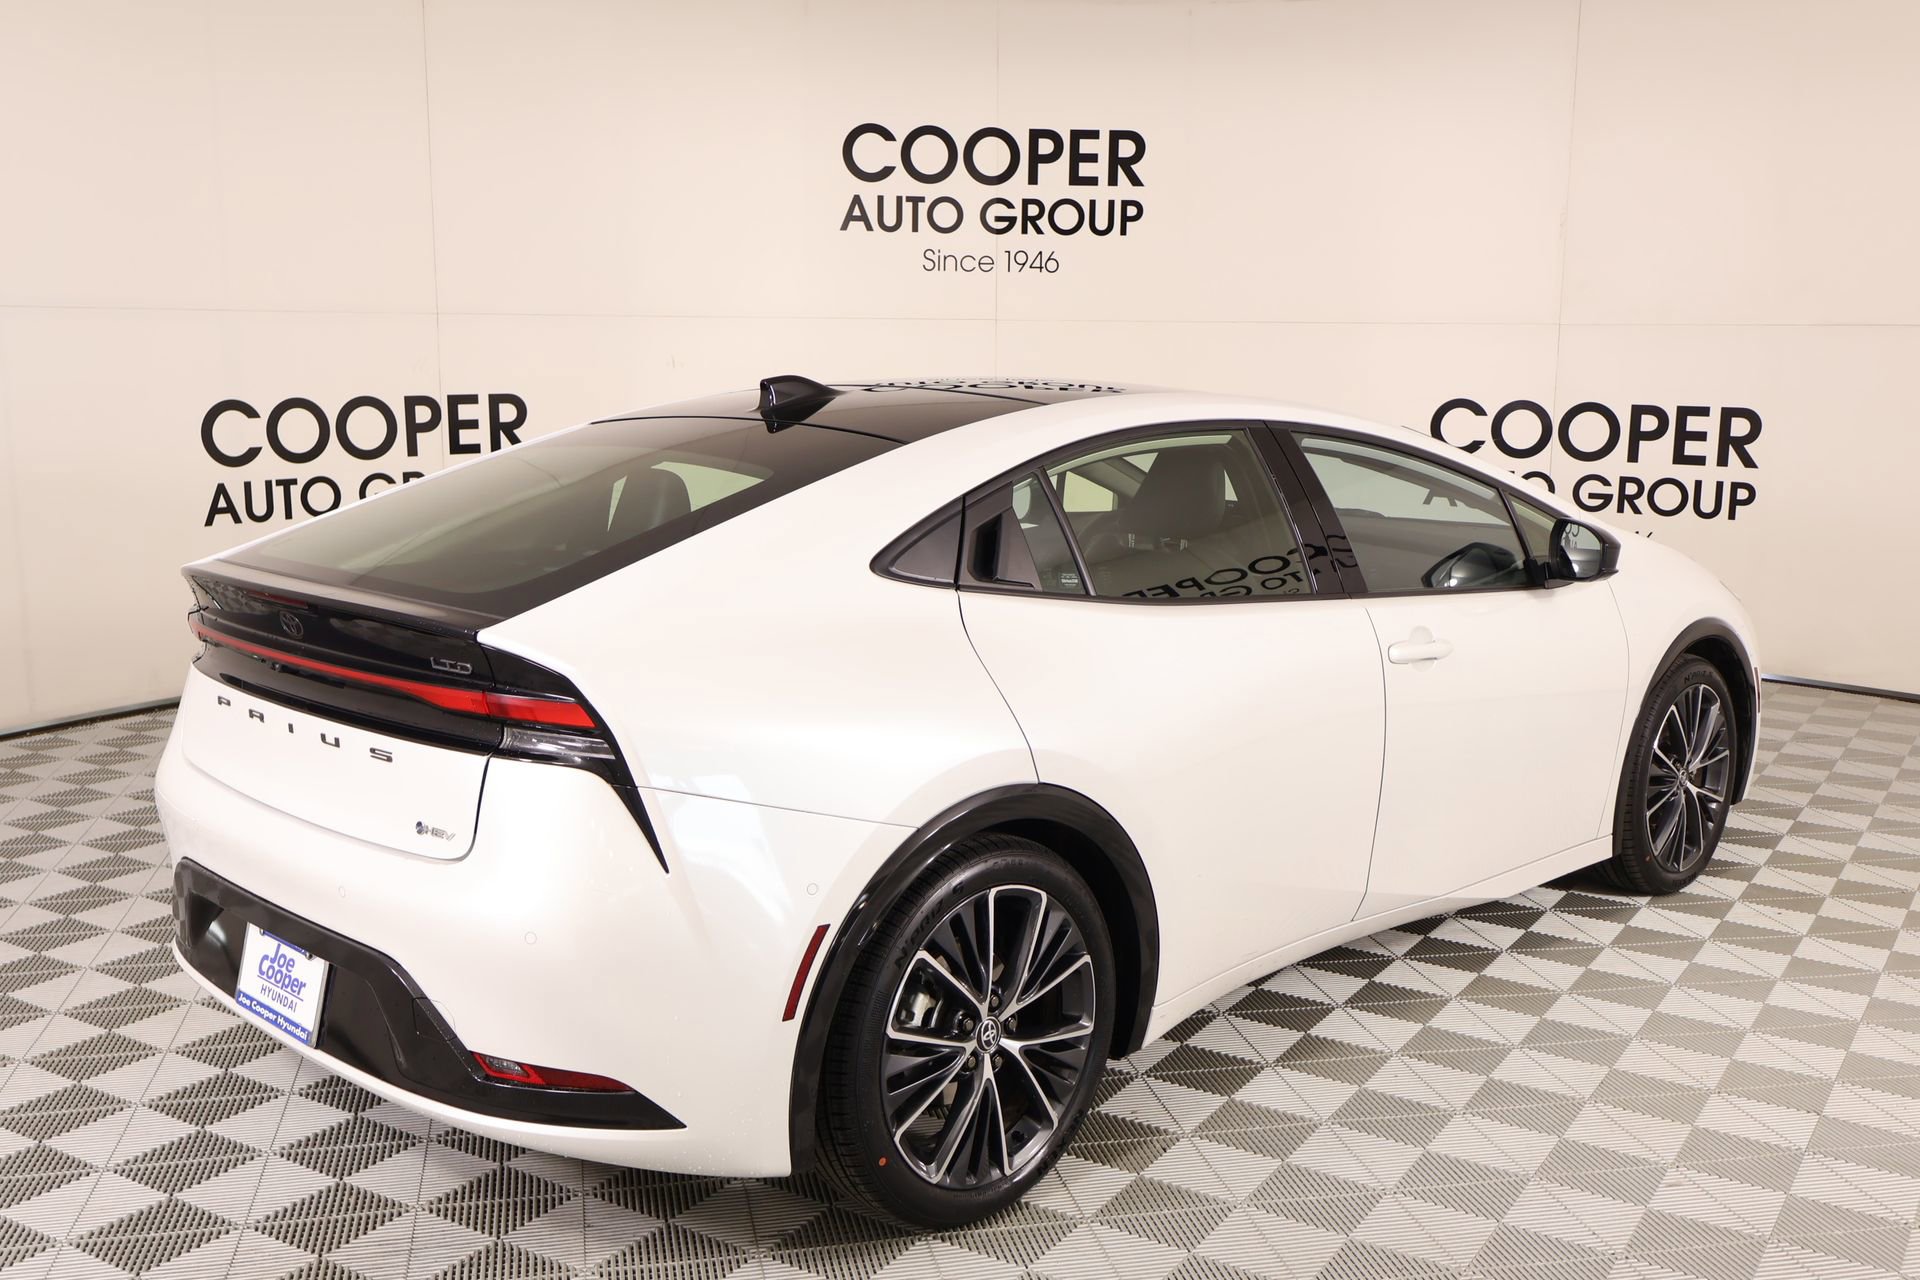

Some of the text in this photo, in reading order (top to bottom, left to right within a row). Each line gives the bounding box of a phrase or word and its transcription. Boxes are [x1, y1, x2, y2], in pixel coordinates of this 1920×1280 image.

[842, 123, 1146, 187] COOPER
[840, 194, 1144, 236] AUTO GROUP
[922, 249, 1060, 273] Since 1946
[201, 393, 528, 468] COOPER
[1430, 398, 1763, 469] COOPER
[204, 475, 342, 527] AUTO
[1572, 474, 1756, 520] GROUP
[430, 657, 472, 675] LTD
[217, 695, 394, 764] PRIUS
[424, 825, 456, 841] HEV
[258, 954, 307, 996] Cooper
[270, 943, 295, 973] Joe
[238, 993, 308, 1040] Joe Cooper Hyundai
[260, 983, 298, 1013] HYUNDAI
